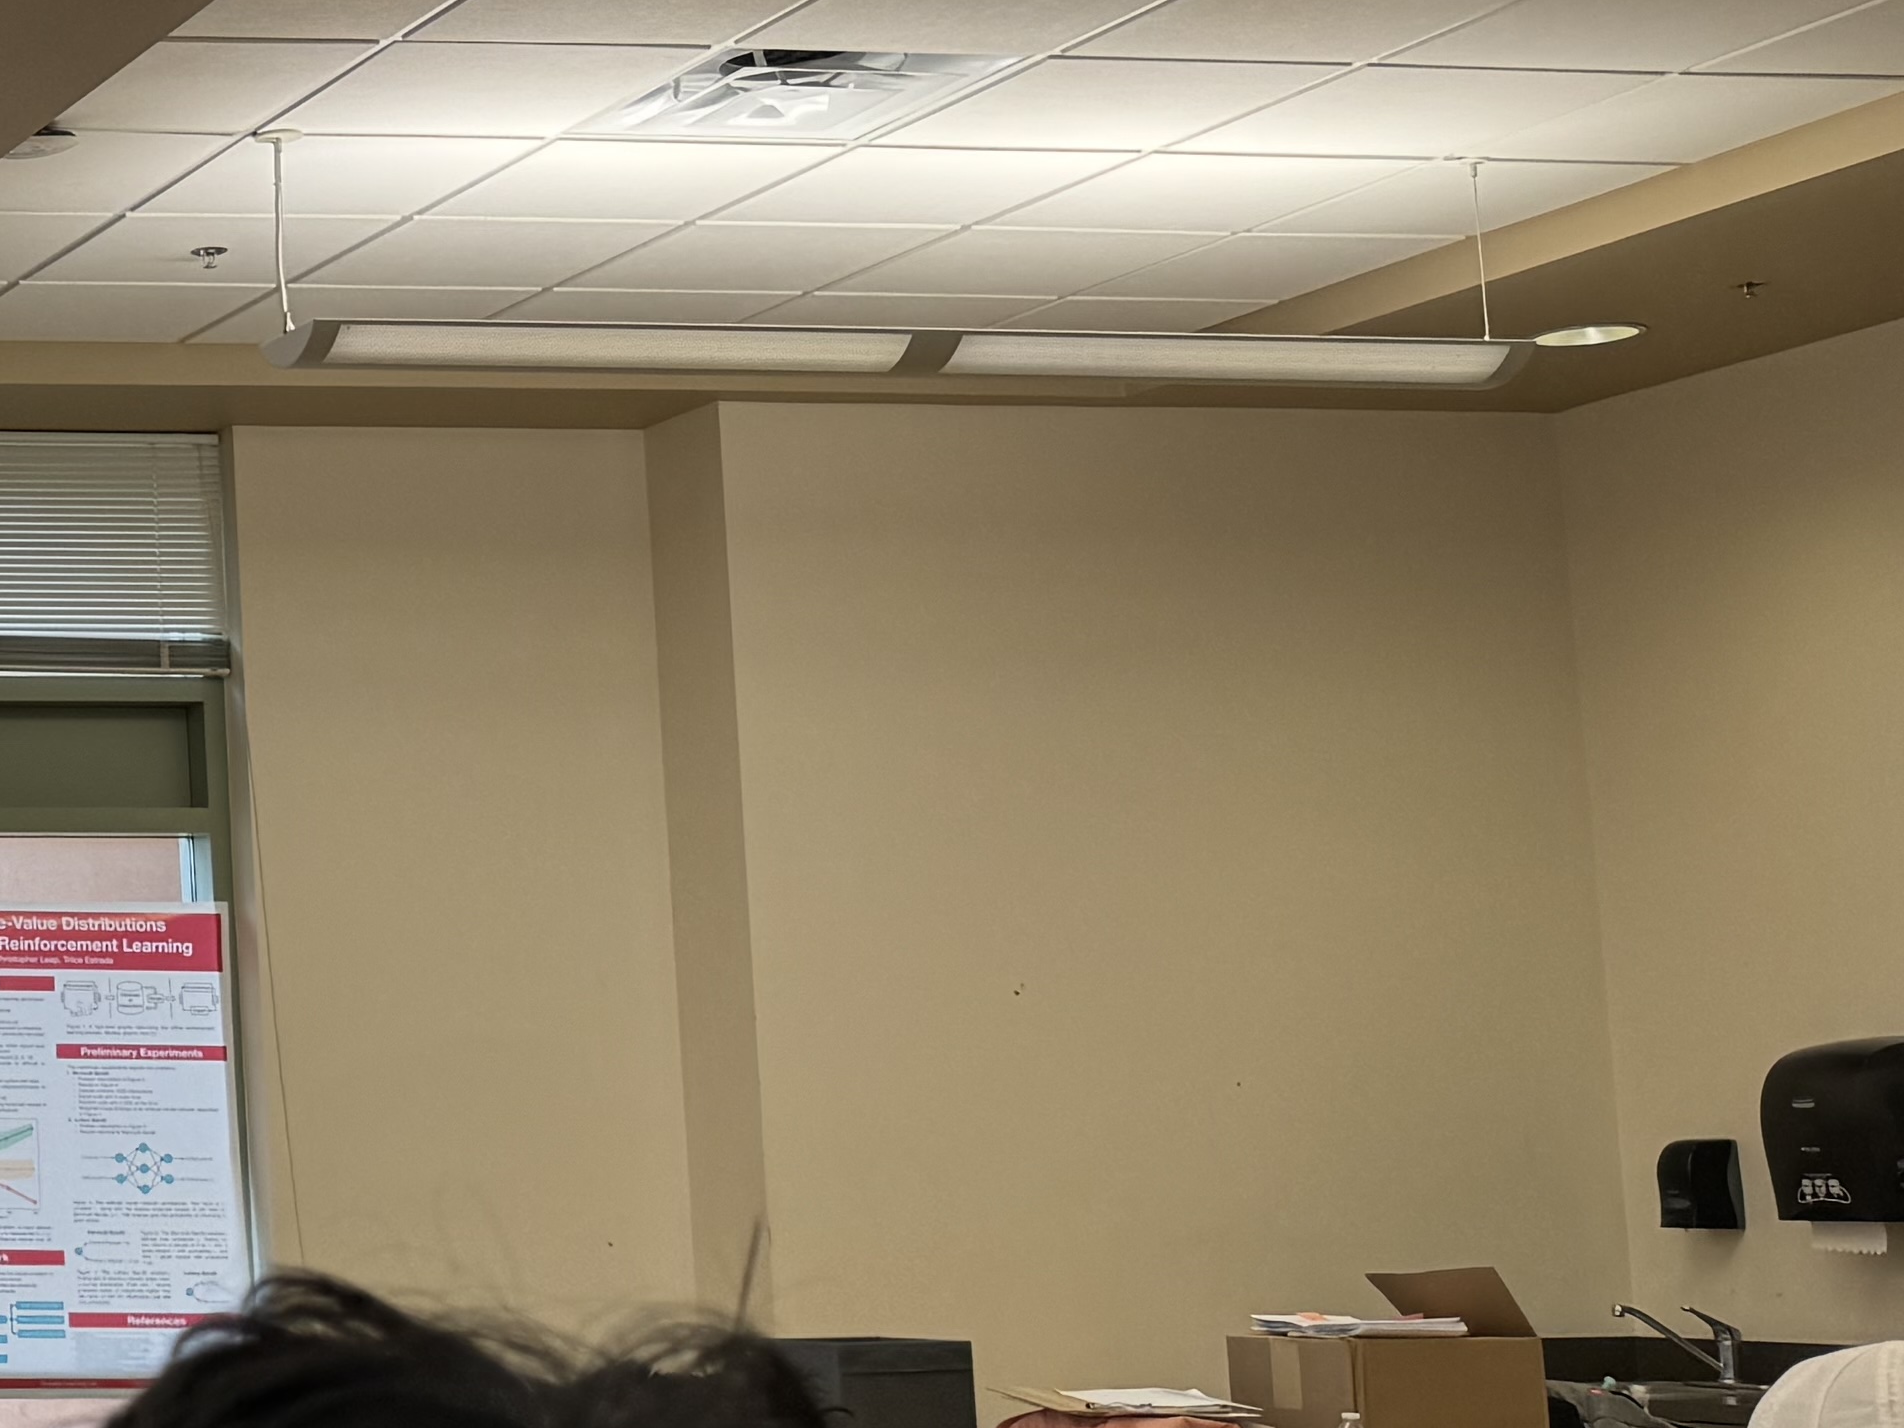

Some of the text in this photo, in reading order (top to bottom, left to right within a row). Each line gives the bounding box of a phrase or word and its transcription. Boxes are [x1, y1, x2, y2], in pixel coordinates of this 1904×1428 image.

[61, 917, 167, 933] Distributions
[122, 938, 193, 957] Learning
[80, 1046, 204, 1059] Preliminary Experiments
[127, 1315, 187, 1327] References
